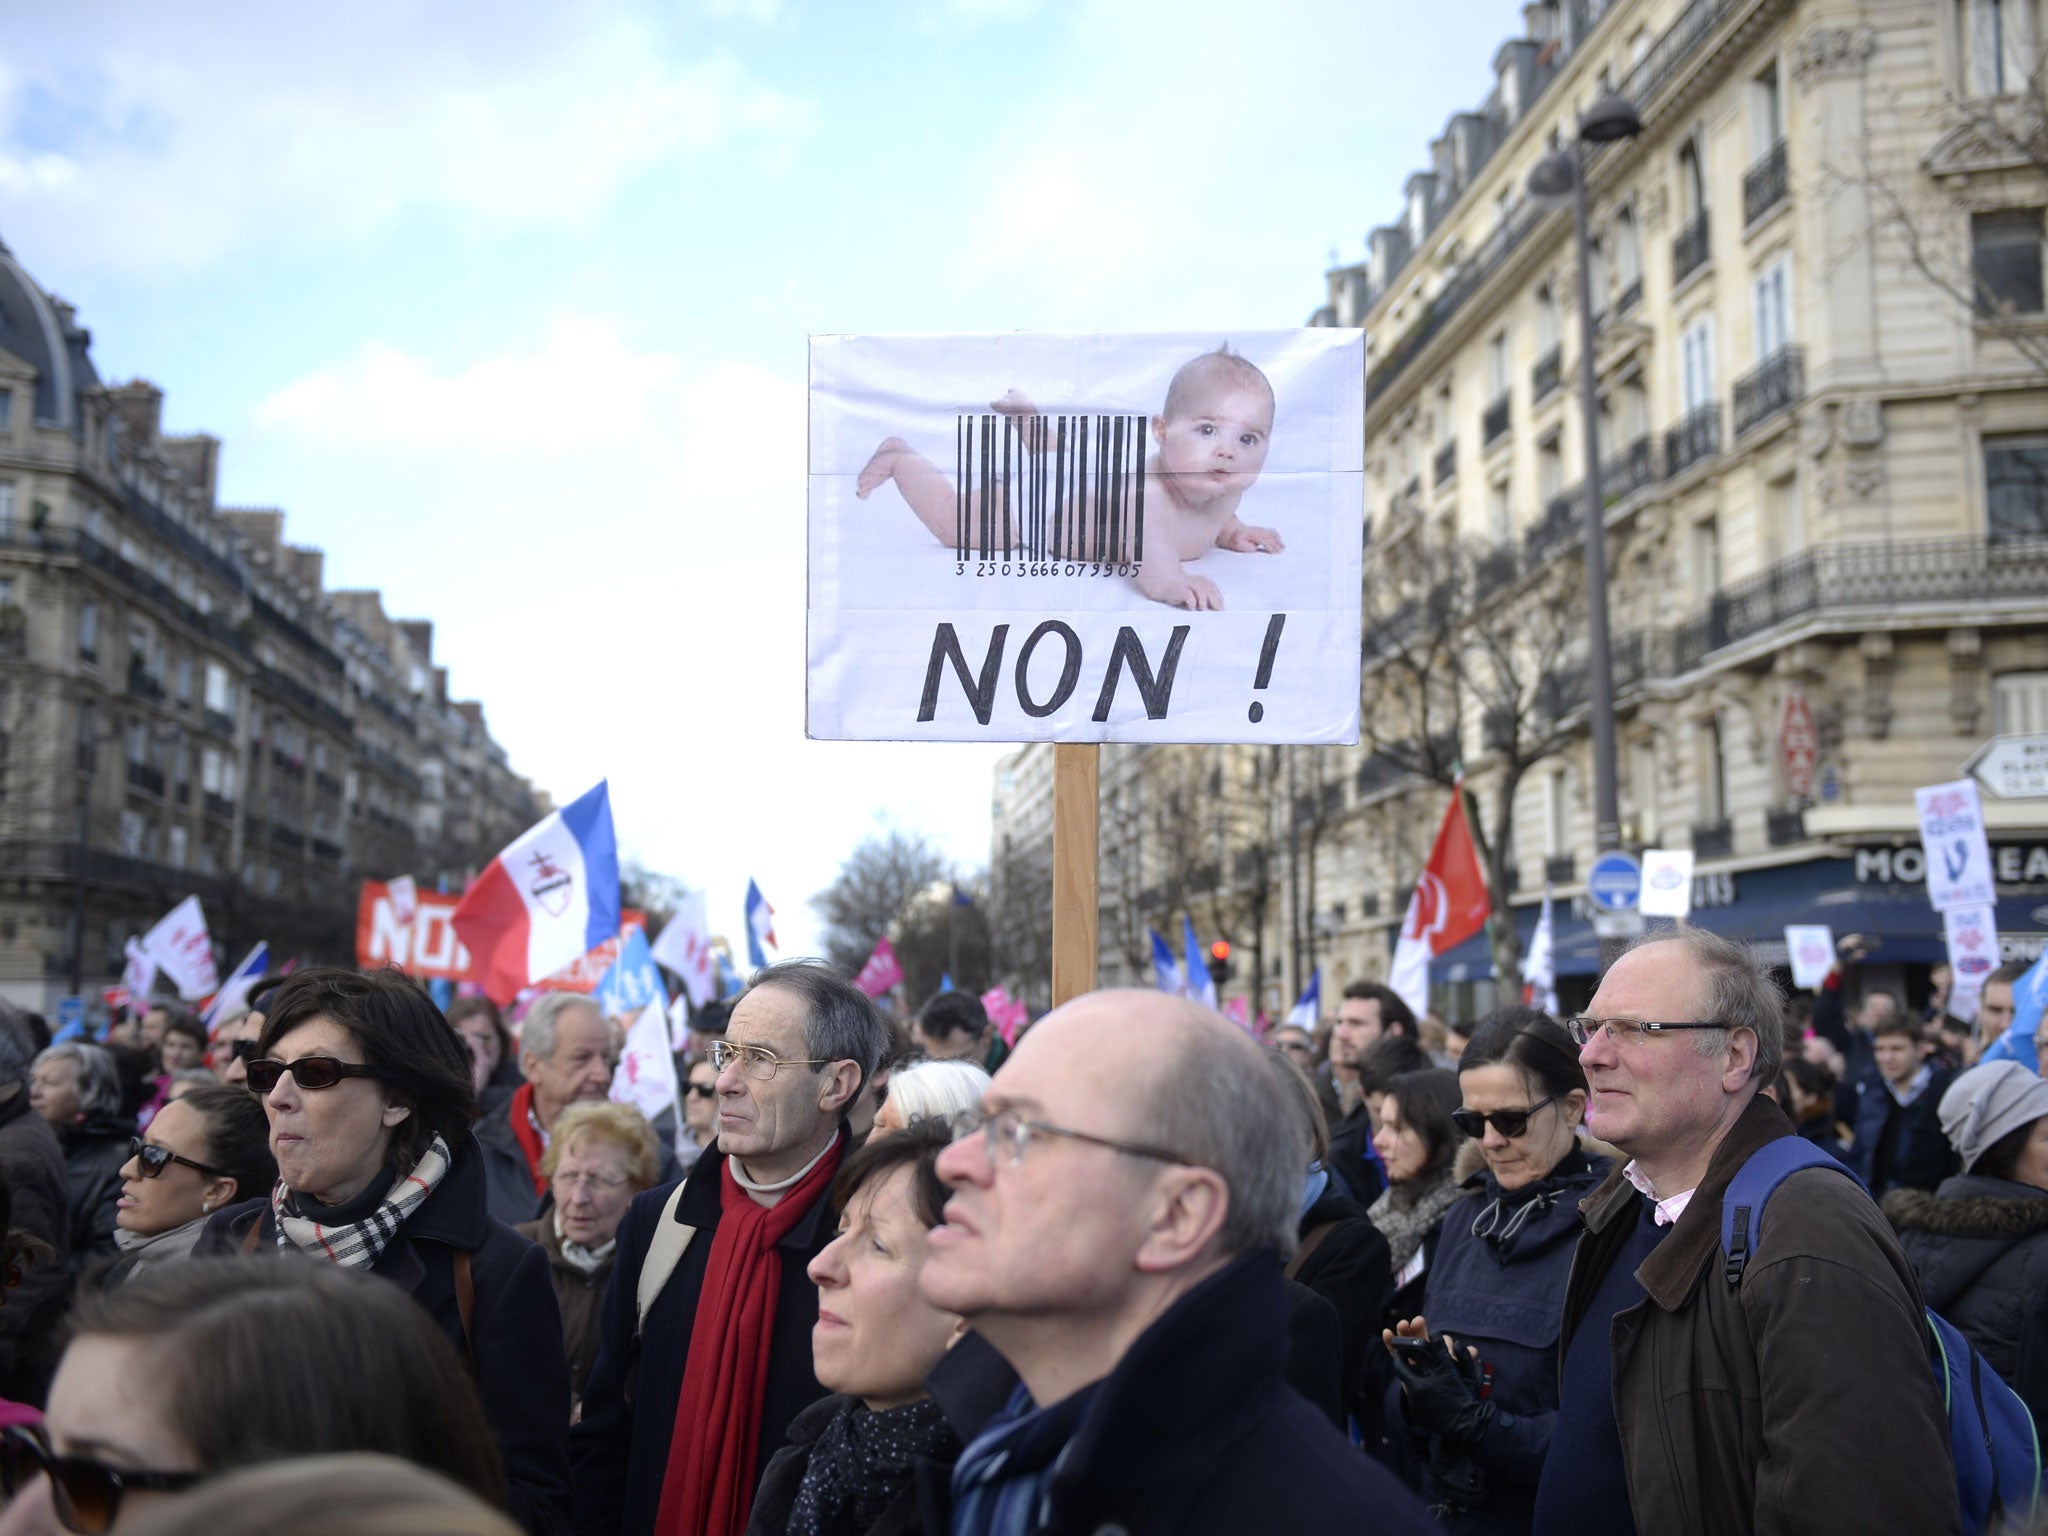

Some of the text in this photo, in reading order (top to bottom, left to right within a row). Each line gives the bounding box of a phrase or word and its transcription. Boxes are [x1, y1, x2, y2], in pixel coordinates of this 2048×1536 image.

[955, 562, 965, 576] 3
[917, 613, 1286, 725] NON !
[368, 897, 472, 973] NO
